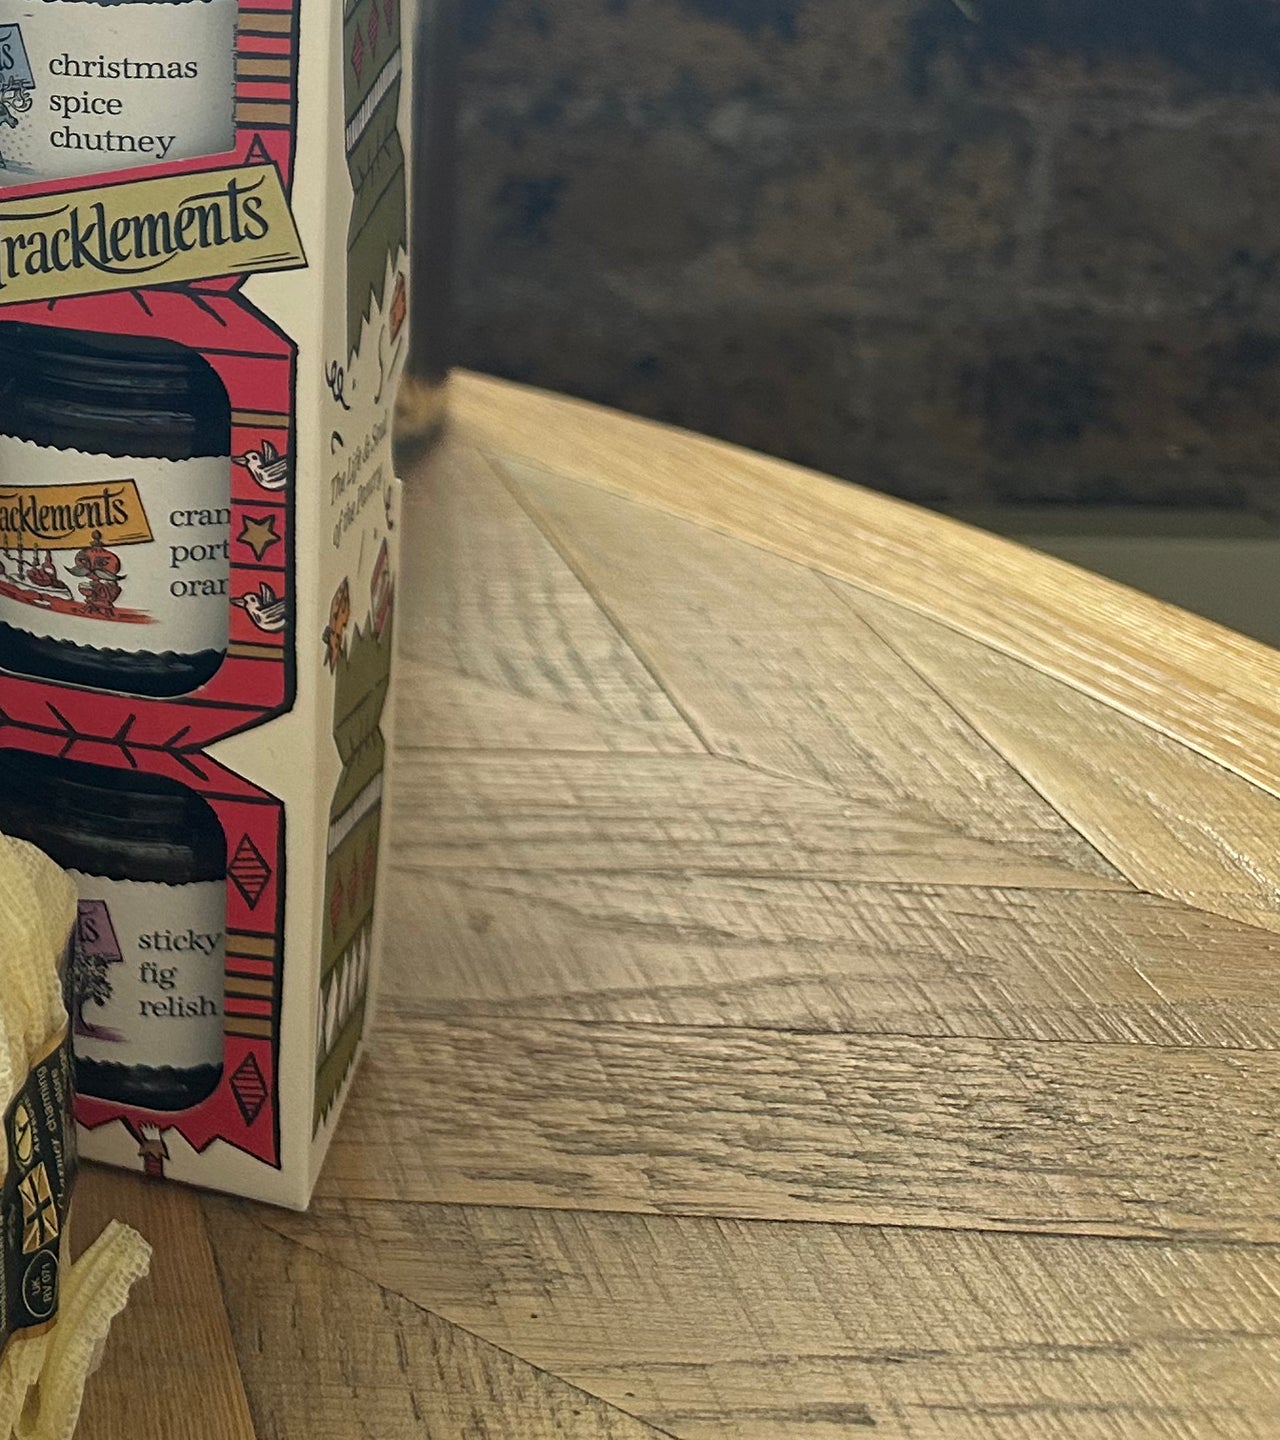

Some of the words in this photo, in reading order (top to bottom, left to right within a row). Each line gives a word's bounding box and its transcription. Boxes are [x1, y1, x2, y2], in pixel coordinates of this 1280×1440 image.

[49, 53, 198, 80] christmas
[49, 93, 122, 117] spice
[49, 126, 176, 158] chutney
[170, 508, 231, 527] cran
[169, 539, 230, 569] port
[138, 929, 222, 955] sticky
[138, 963, 178, 989] fig
[138, 996, 218, 1018] relish
[35, 1065, 58, 1132] charming
[31, 1278, 41, 1295] UK
